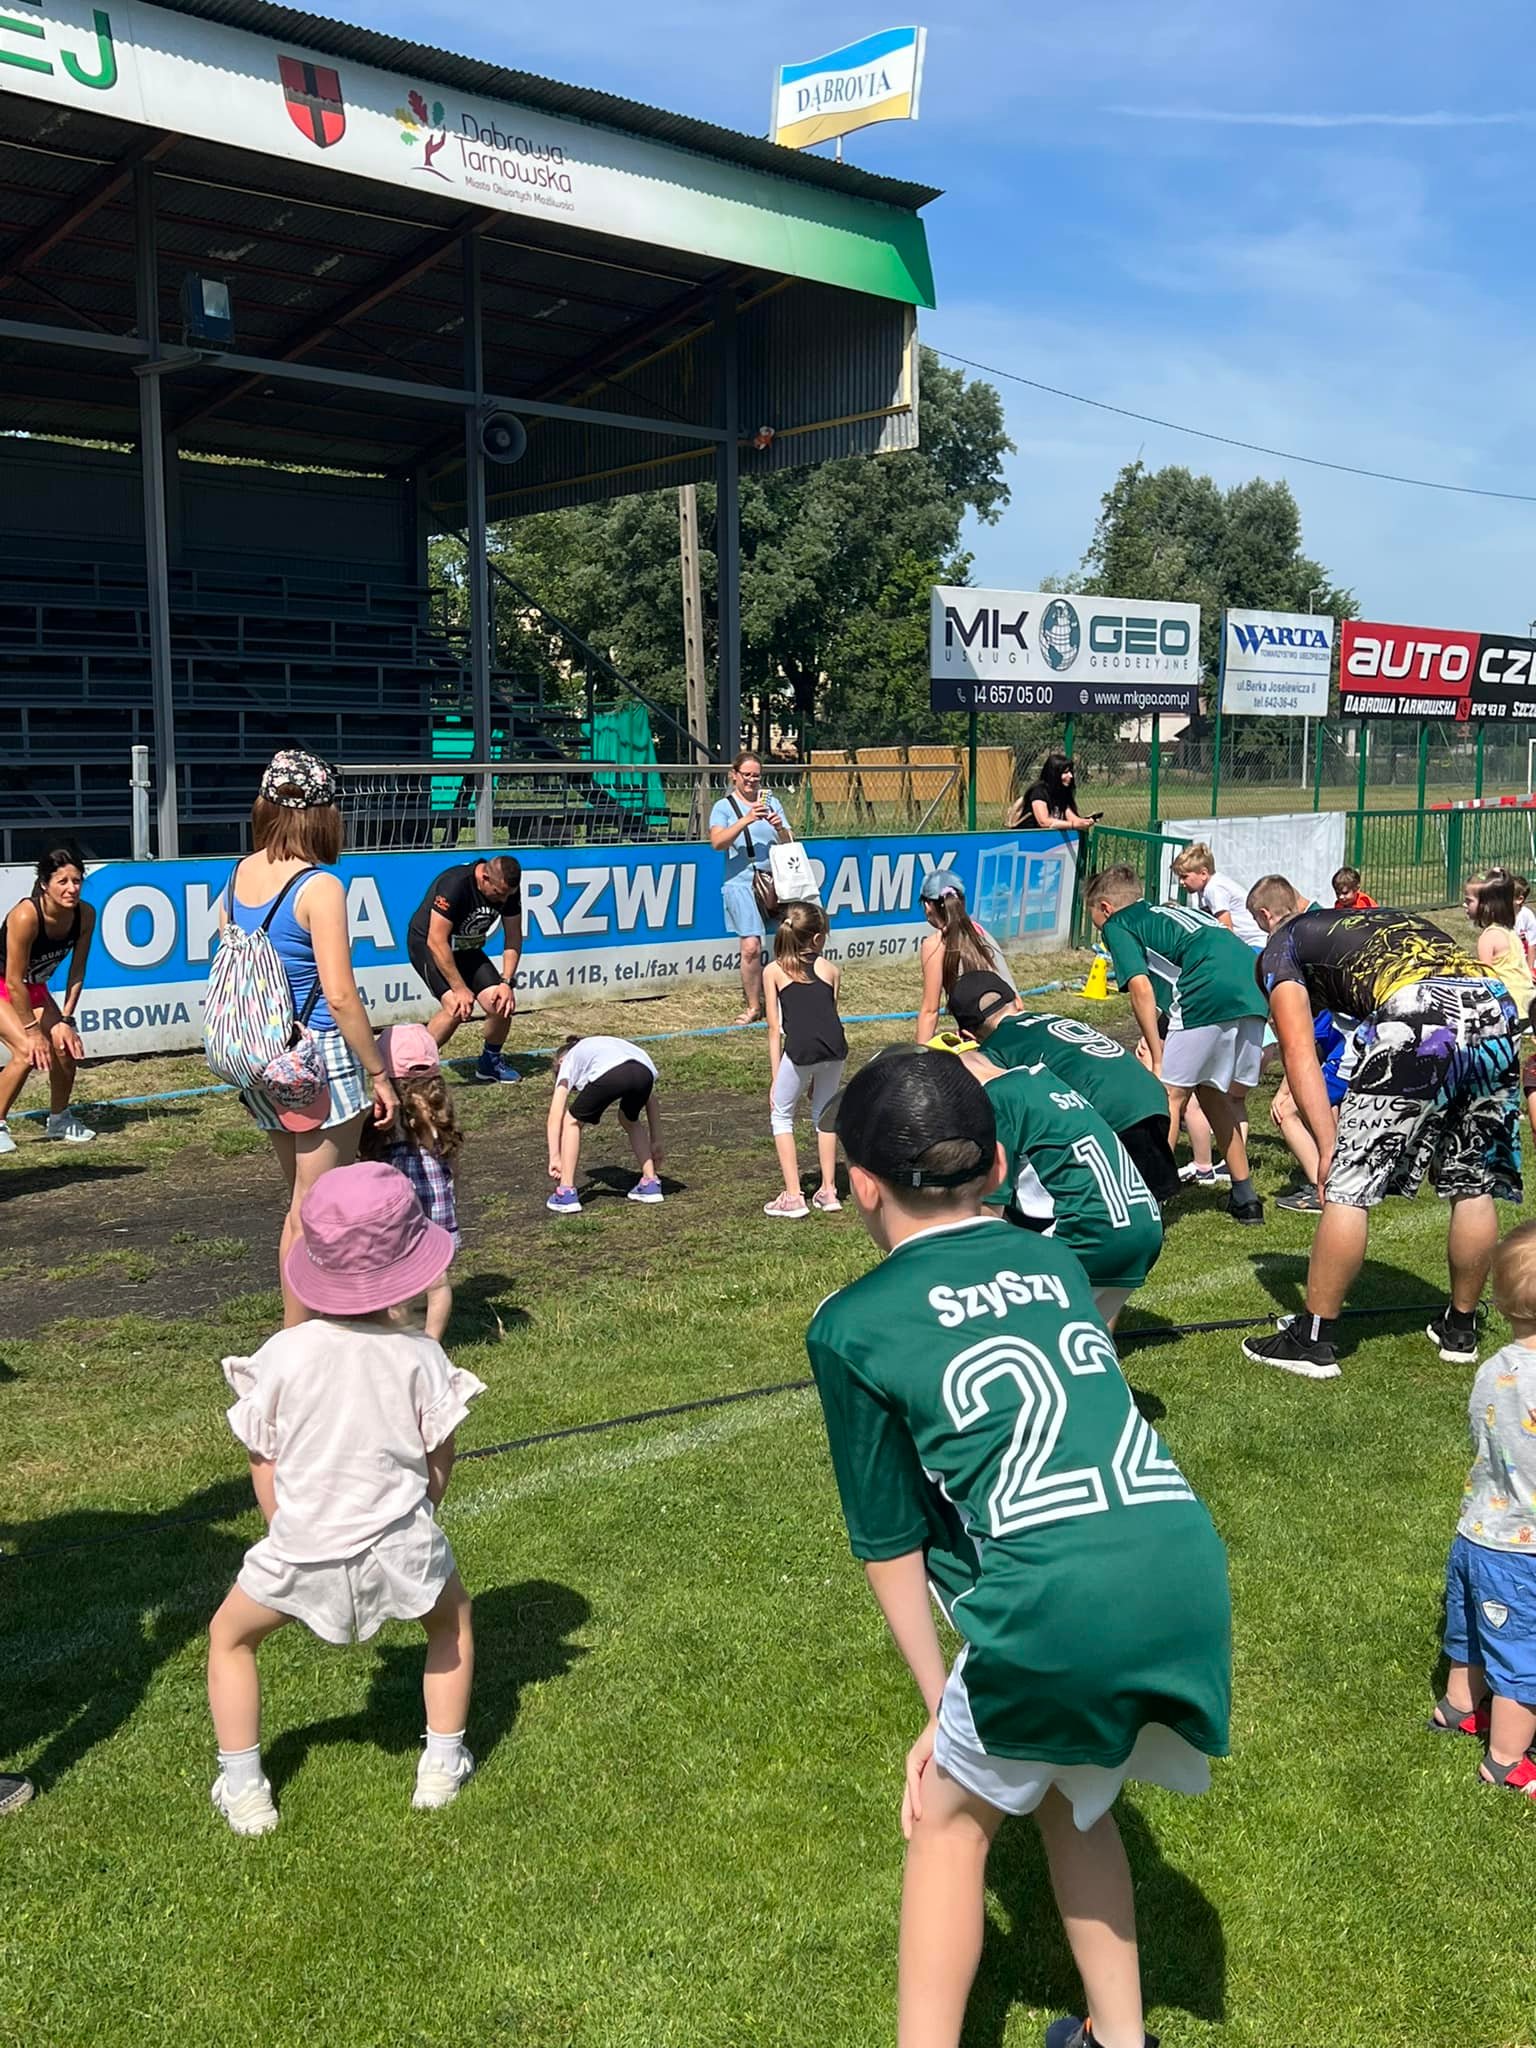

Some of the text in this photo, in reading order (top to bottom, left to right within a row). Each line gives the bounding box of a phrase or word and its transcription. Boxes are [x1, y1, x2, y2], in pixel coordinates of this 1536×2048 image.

[796, 69, 893, 112] DĄBROVIA
[462, 113, 564, 165] Dąbrowa
[453, 135, 573, 193] Tarnowska
[465, 176, 491, 192] Miasto
[945, 606, 1191, 656] MK GEO
[1229, 622, 1330, 655] WARTA
[945, 651, 1189, 671] USŁUGI GEODEZYJNE
[1479, 649, 1536, 685] CZ
[974, 686, 987, 703] 14
[989, 685, 1015, 704] 657
[1016, 686, 1034, 704] 05
[1036, 686, 1053, 705] 00
[1397, 697, 1456, 716] TARNOWSKA
[101, 876, 396, 967] OKA
[486, 863, 696, 937] RZWI
[74, 1002, 191, 1033] BROWA
[384, 982, 421, 1003] UL.
[566, 964, 608, 986] 11B,
[615, 959, 678, 981] tel./fax
[685, 954, 706, 974] 14
[849, 940, 875, 958] 697
[879, 937, 906, 955] 507
[1071, 1126, 1161, 1228] 14
[942, 1321, 1197, 1538] 22
